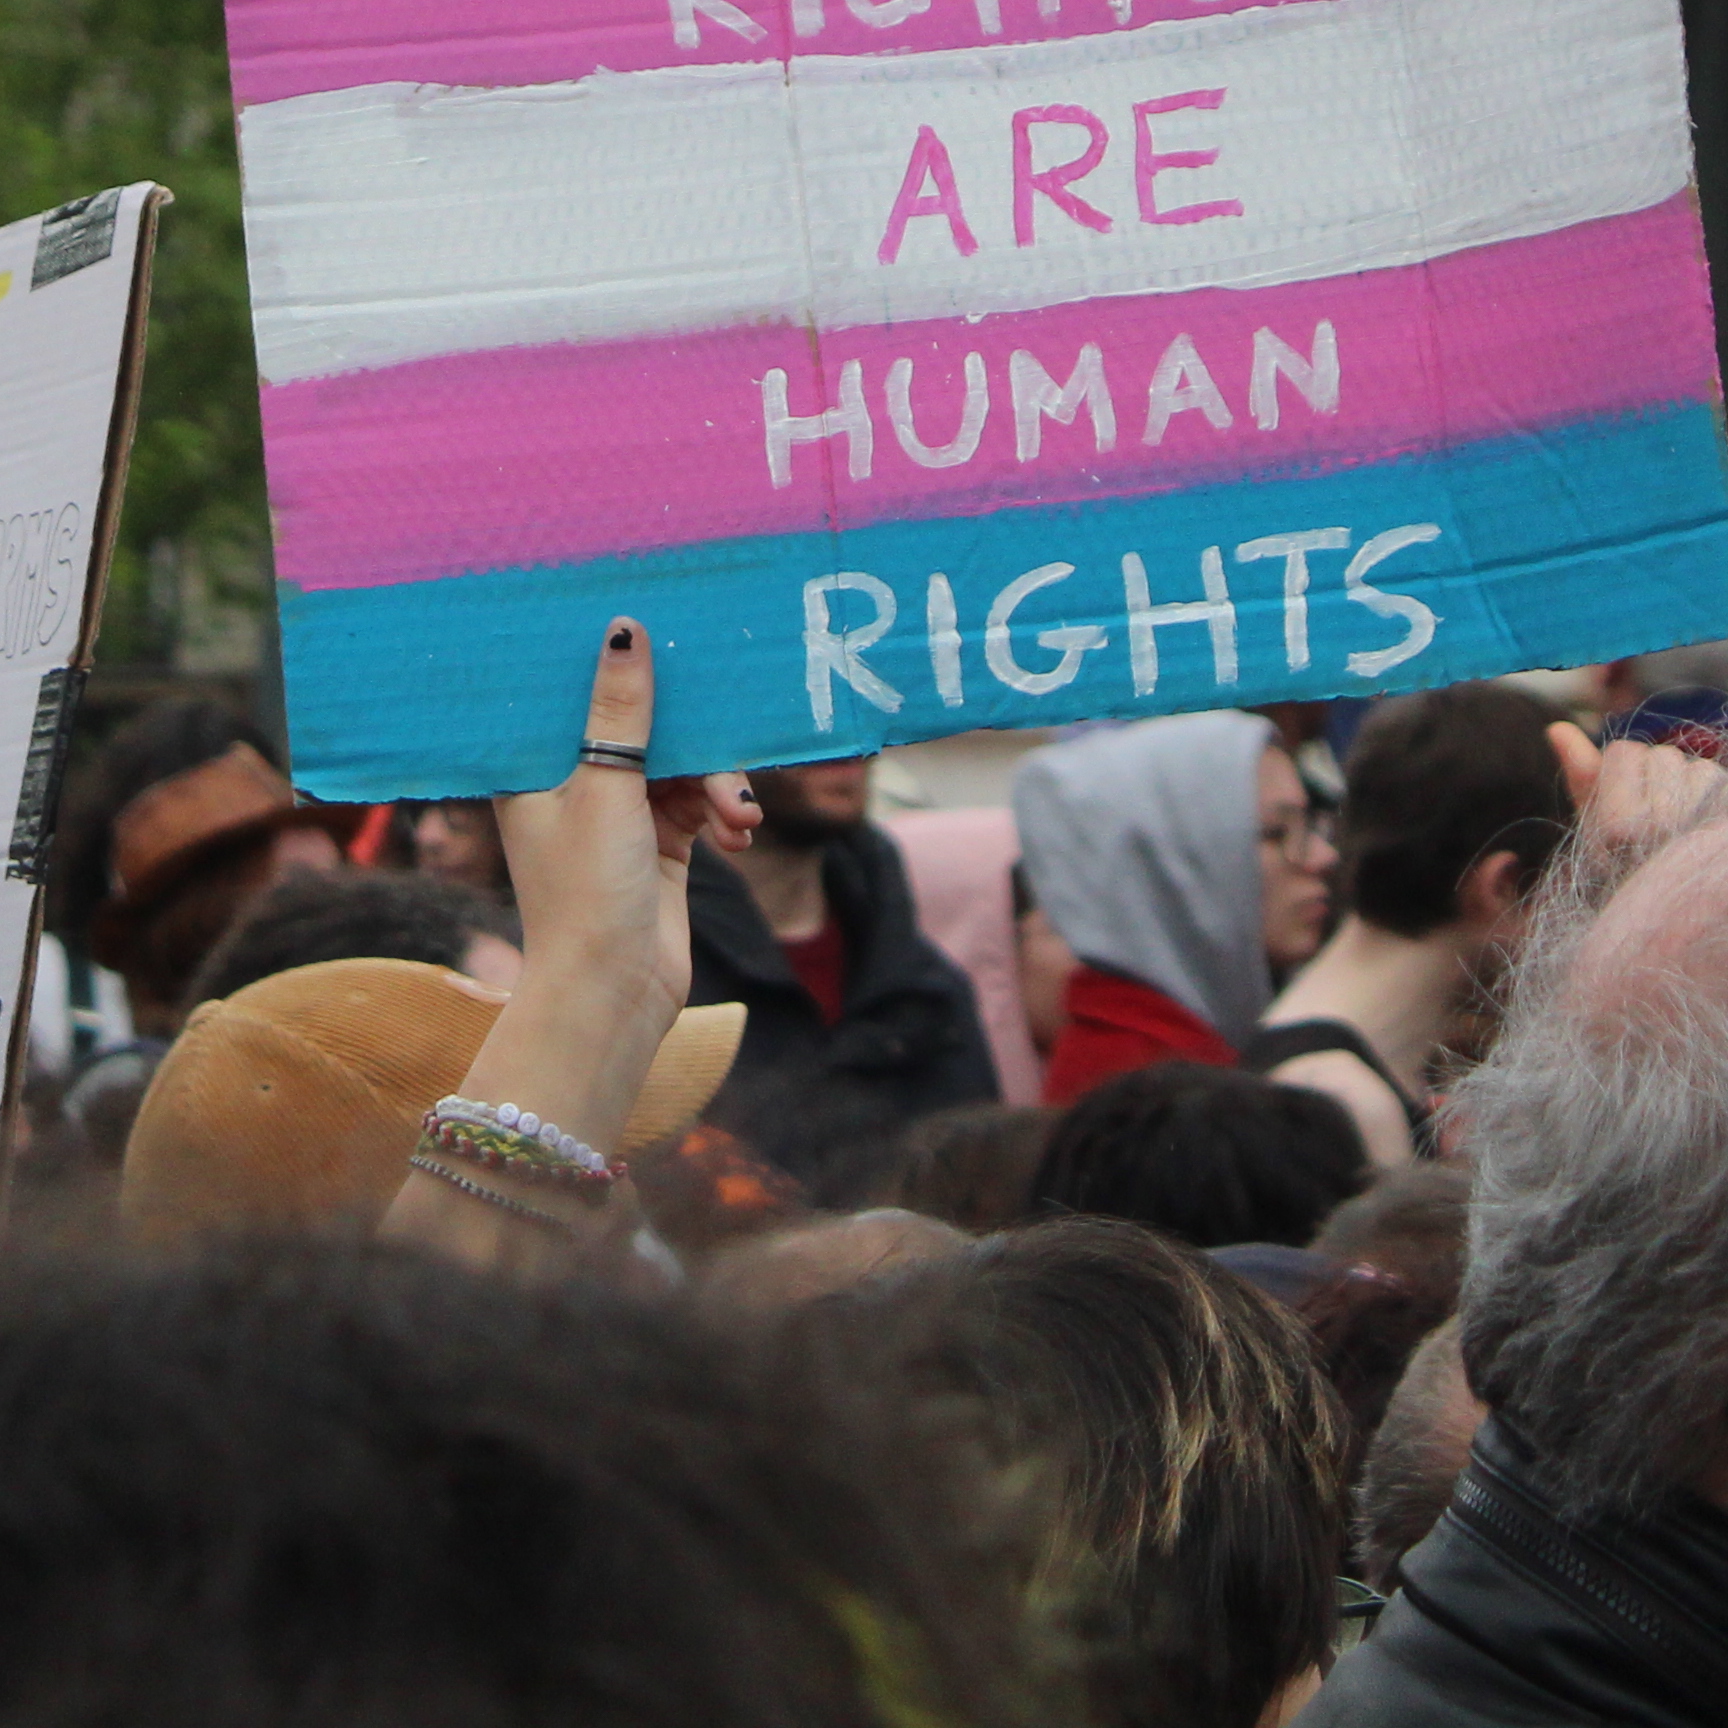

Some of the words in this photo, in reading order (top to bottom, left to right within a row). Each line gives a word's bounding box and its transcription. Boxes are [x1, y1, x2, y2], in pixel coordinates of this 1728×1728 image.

[877, 86, 1246, 267] ARE
[758, 317, 1342, 487] HUMAN
[801, 521, 1445, 732] RIGHTS
